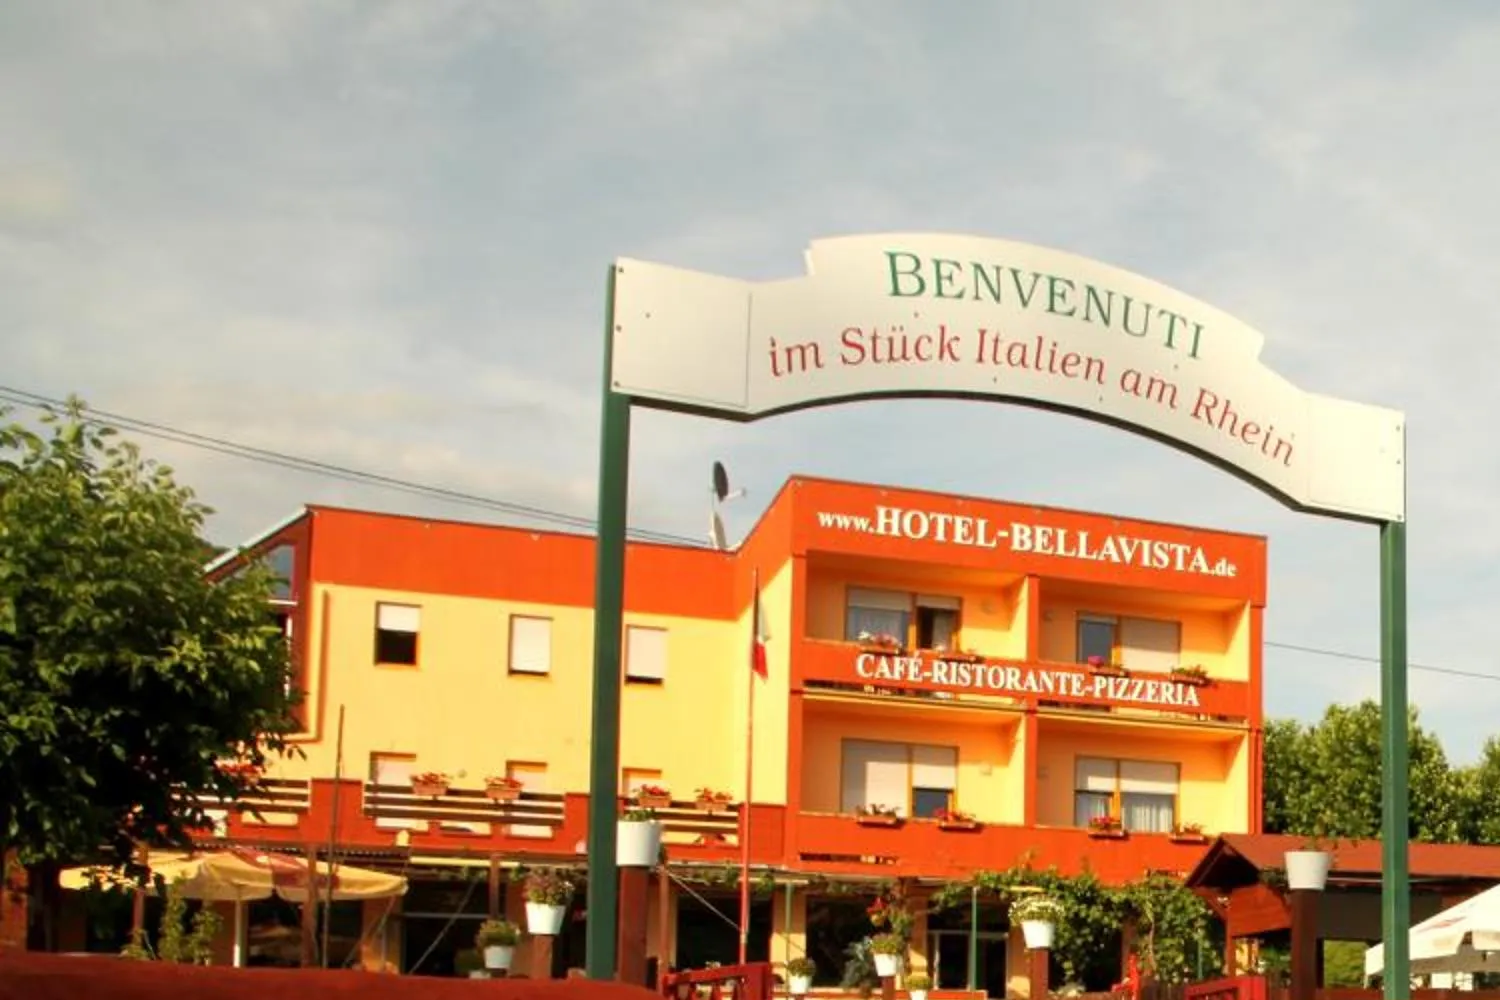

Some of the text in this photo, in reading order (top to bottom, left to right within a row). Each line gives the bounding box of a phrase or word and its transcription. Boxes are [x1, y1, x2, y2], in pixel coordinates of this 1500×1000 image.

[884, 251, 1206, 360] BENVENUTI
[769, 325, 1296, 467] im Stück Italien am Rhein
[817, 505, 1237, 577] www.HOTEL-BELLAVISTA.de
[855, 650, 1200, 707] CAFÉ-RISTORANTE-PIZZERIA
